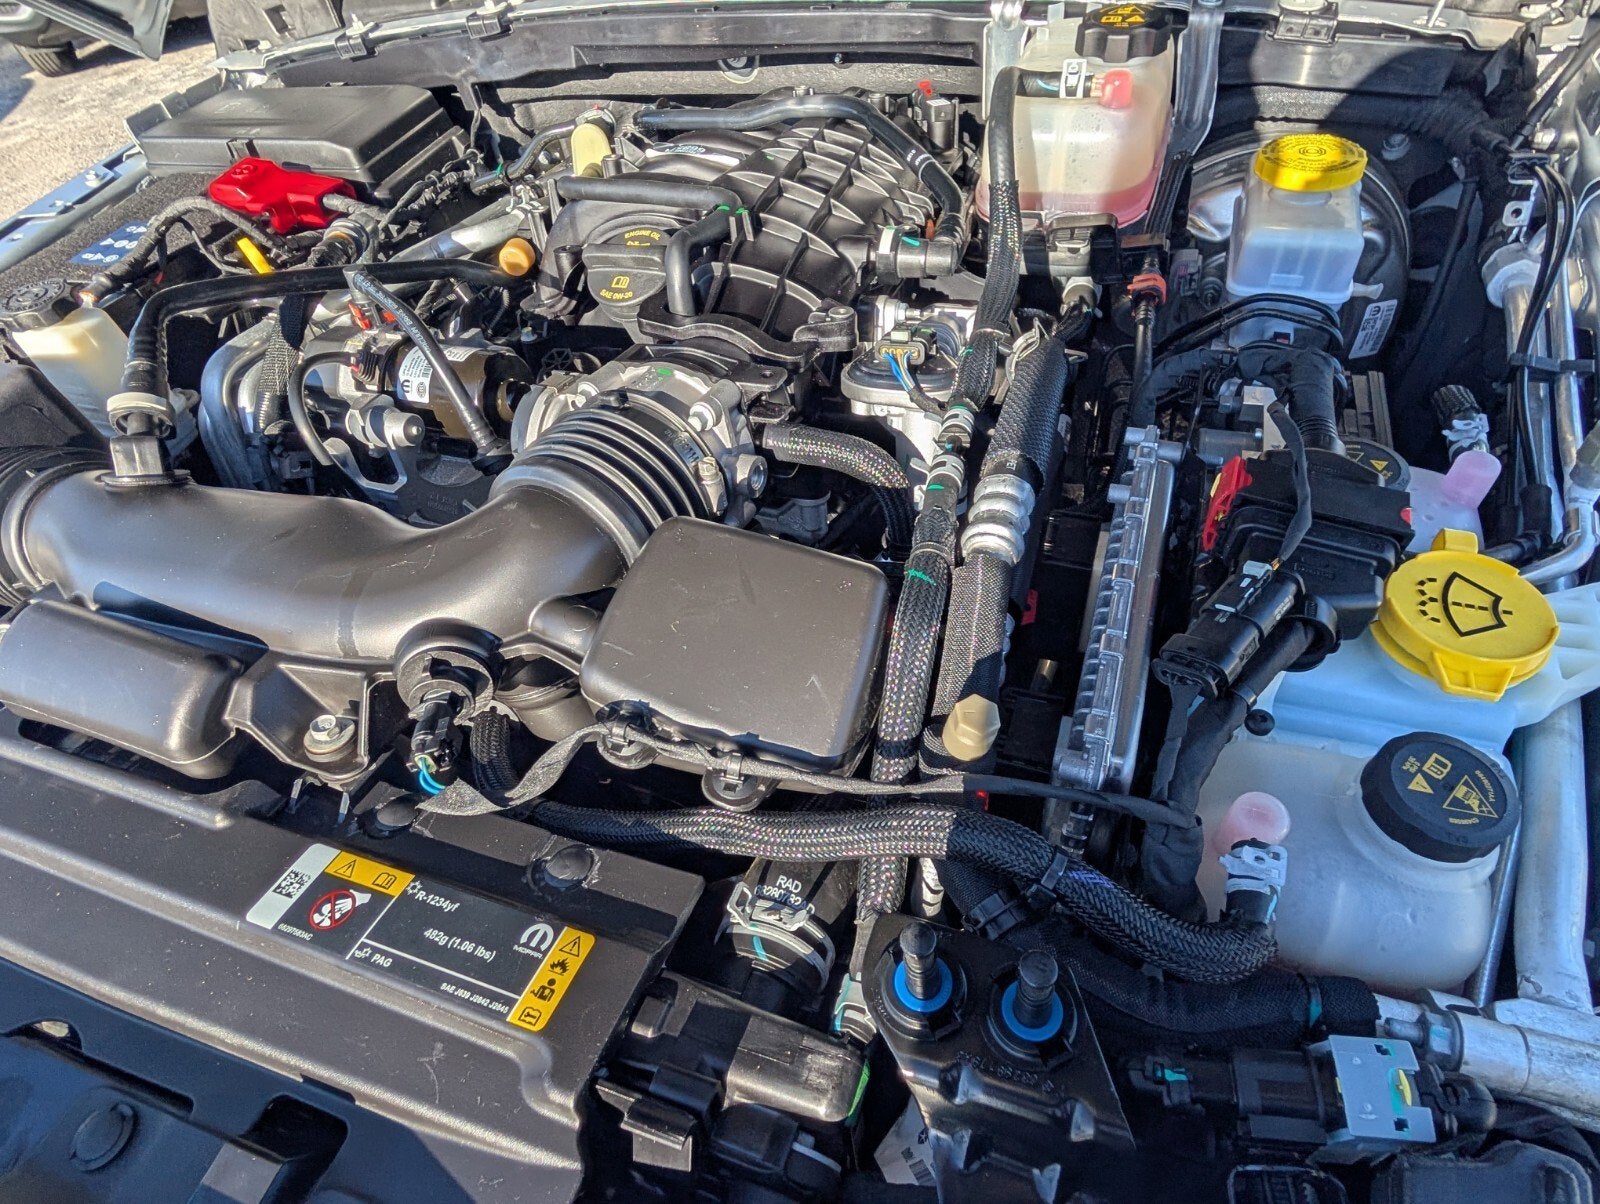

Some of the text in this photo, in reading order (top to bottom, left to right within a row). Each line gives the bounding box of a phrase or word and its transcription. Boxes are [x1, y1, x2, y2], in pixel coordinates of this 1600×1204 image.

[624, 229, 661, 241] ENGINE OIL
[599, 288, 613, 300] SAE
[776, 874, 802, 894] RAD
[415, 888, 461, 914] R-1234yf
[423, 926, 498, 963] 482g (1.06 lbs)
[512, 944, 543, 959] MOPAR
[371, 953, 393, 968] PAG
[439, 981, 459, 995] SAE
[457, 985, 472, 1001] J639
[471, 991, 491, 1007] J2842
